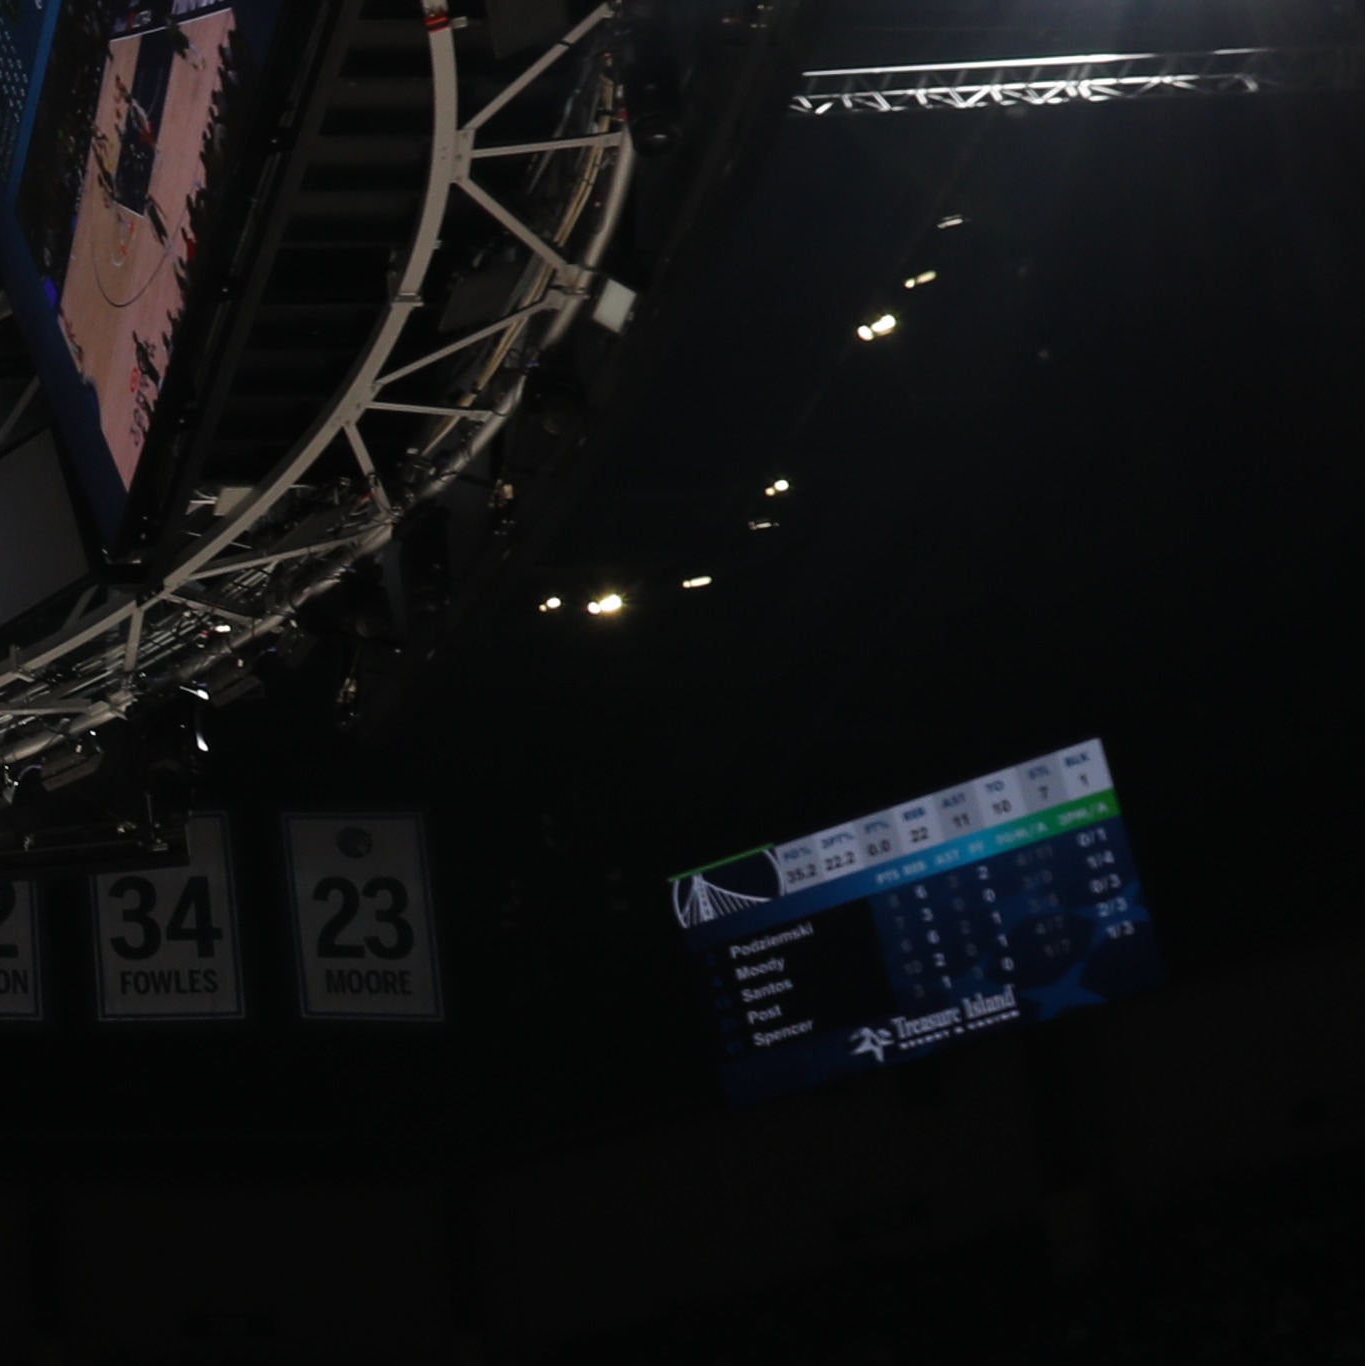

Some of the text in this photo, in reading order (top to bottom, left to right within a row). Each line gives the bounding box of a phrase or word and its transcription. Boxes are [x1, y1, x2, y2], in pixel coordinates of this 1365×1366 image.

[107, 876, 223, 960] 34
[312, 876, 414, 960] 23
[729, 921, 814, 959] Podziemski
[120, 969, 218, 995] FOWLES
[325, 970, 411, 995] MOORE
[735, 957, 785, 981] Moody
[741, 978, 793, 1002] Santos
[747, 1004, 783, 1024] Post
[890, 984, 1017, 1038] Treasure Island
[753, 1019, 814, 1047] Spencer
